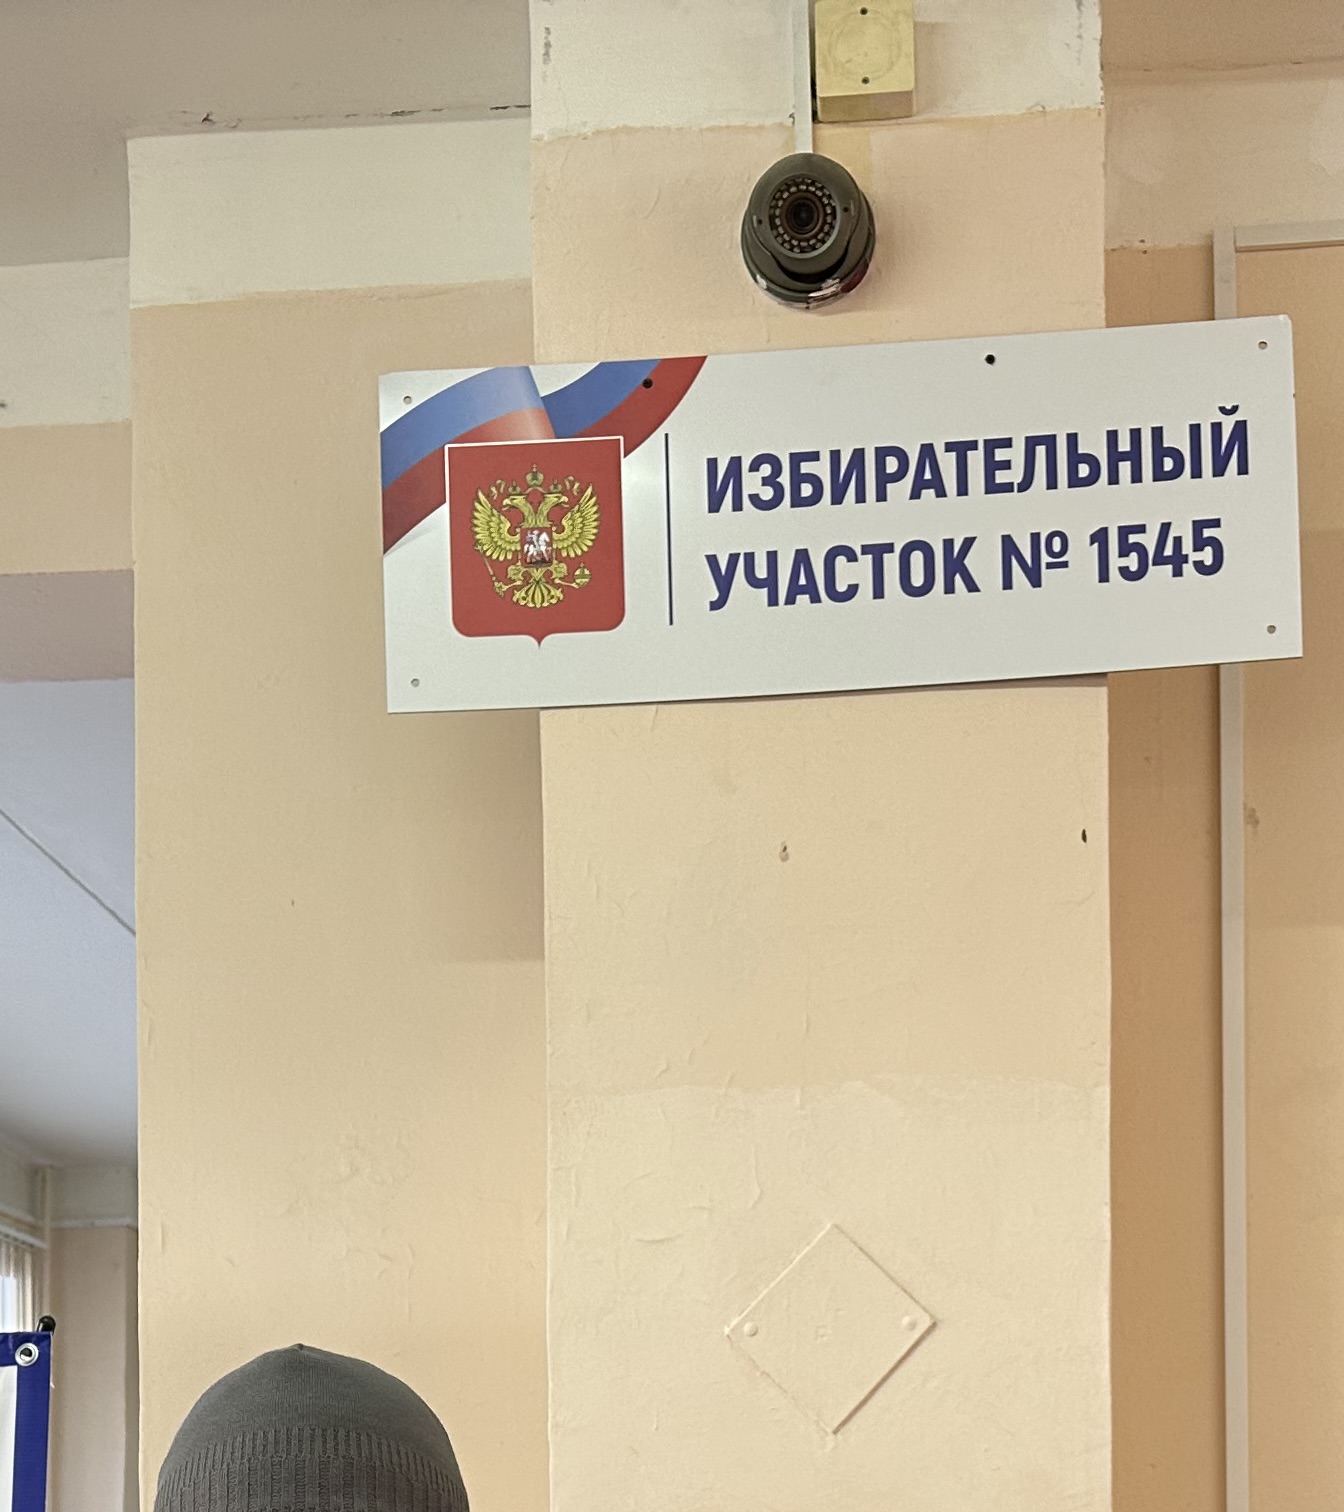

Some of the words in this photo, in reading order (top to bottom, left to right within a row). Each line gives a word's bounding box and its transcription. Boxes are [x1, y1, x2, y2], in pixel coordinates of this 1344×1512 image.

[706, 403, 1250, 514] ИЗБИРАТЕЛЬНЫЙ
[705, 535, 982, 612] УЧАСТОК
[1000, 529, 1070, 591] №
[1089, 518, 1225, 584] 1545
